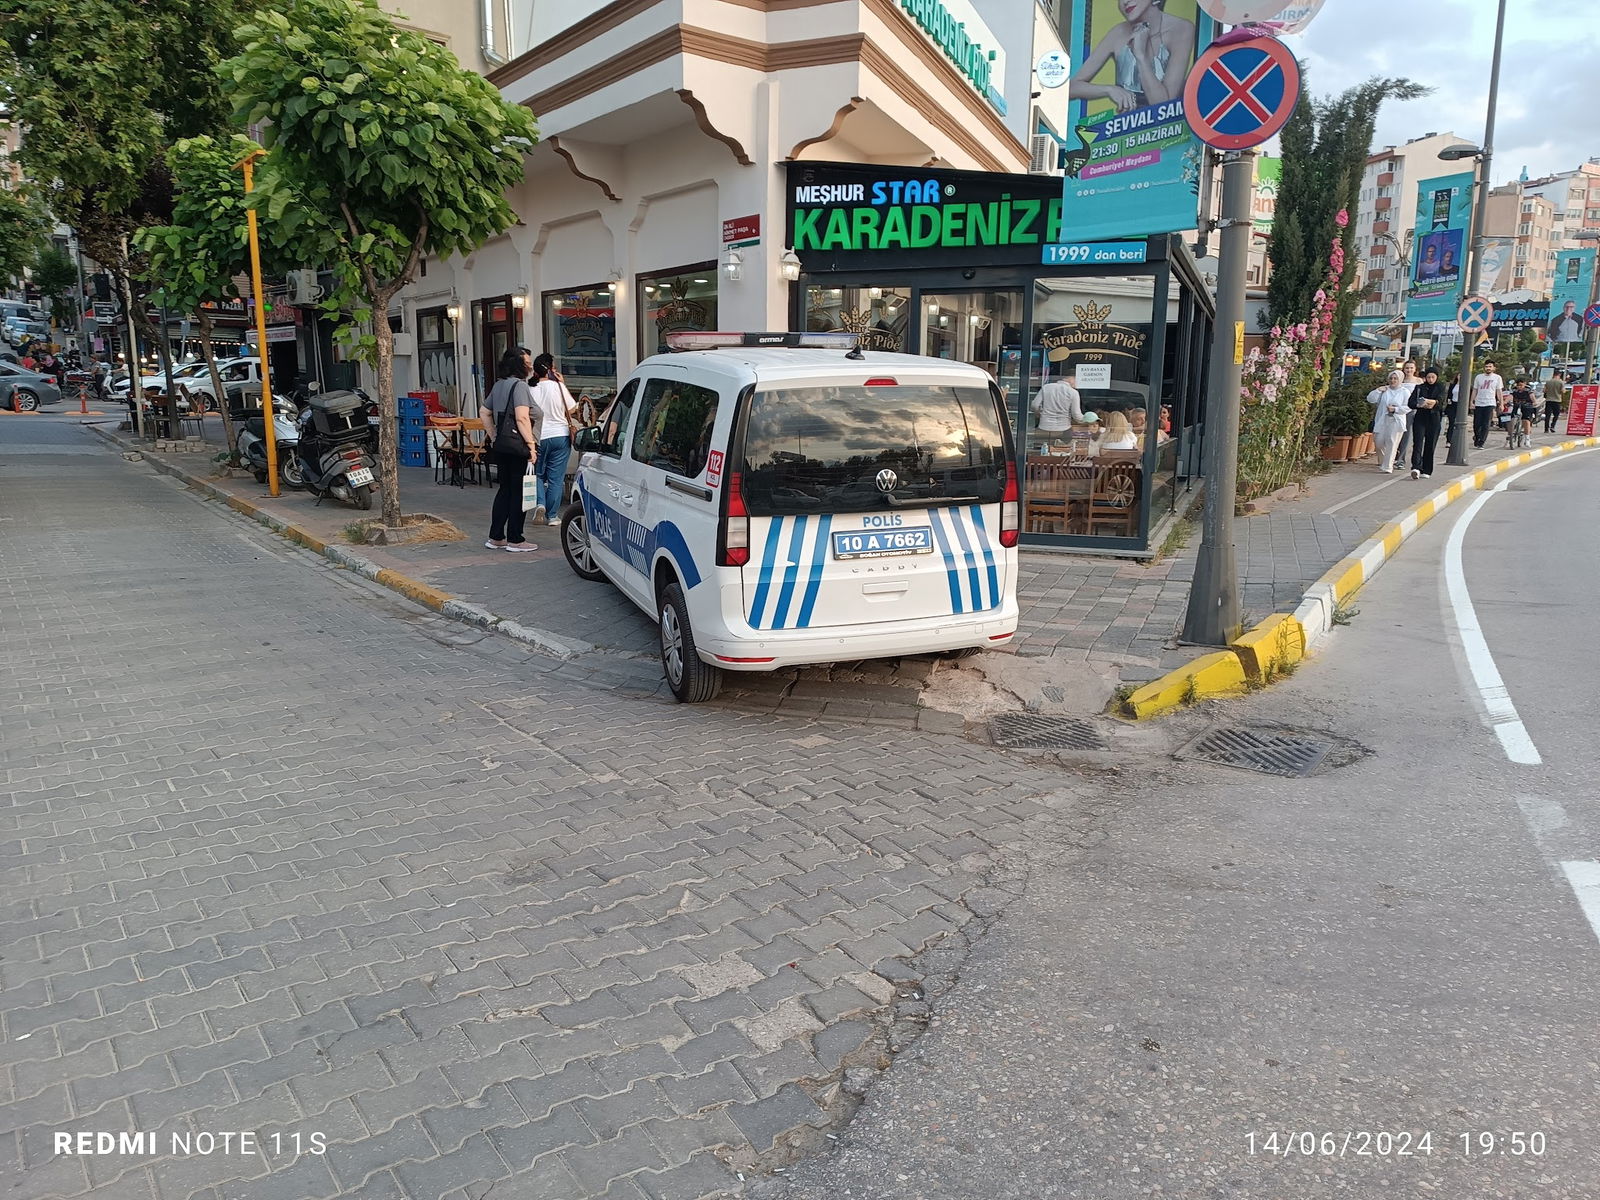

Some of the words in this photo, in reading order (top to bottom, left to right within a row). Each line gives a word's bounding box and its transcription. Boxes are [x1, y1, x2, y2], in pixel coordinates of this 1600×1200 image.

[1104, 109, 1154, 138] ŞEVVAL
[1091, 142, 1119, 160] 21:30
[1124, 137, 1136, 149] 15
[1137, 123, 1183, 143] HAZİRAN
[1089, 159, 1125, 176] Cumhuriyet
[795, 184, 865, 205] MEŞHUR
[871, 179, 941, 205] STAR
[793, 193, 1042, 250] KARADENİZ
[1050, 246, 1091, 262] 1999
[1094, 249, 1116, 261] dan
[1119, 248, 1143, 260] beri
[1081, 321, 1104, 330] Star
[874, 335, 900, 351] Pide
[1040, 330, 1109, 349] Karadeniz
[1112, 331, 1143, 350] Pide
[1084, 353, 1103, 361] 1999
[710, 453, 721, 472] 112
[594, 509, 612, 542] POLİS
[863, 512, 903, 528] POLİS
[842, 536, 862, 551] 10
[867, 535, 880, 549] A
[884, 532, 926, 548] 7662
